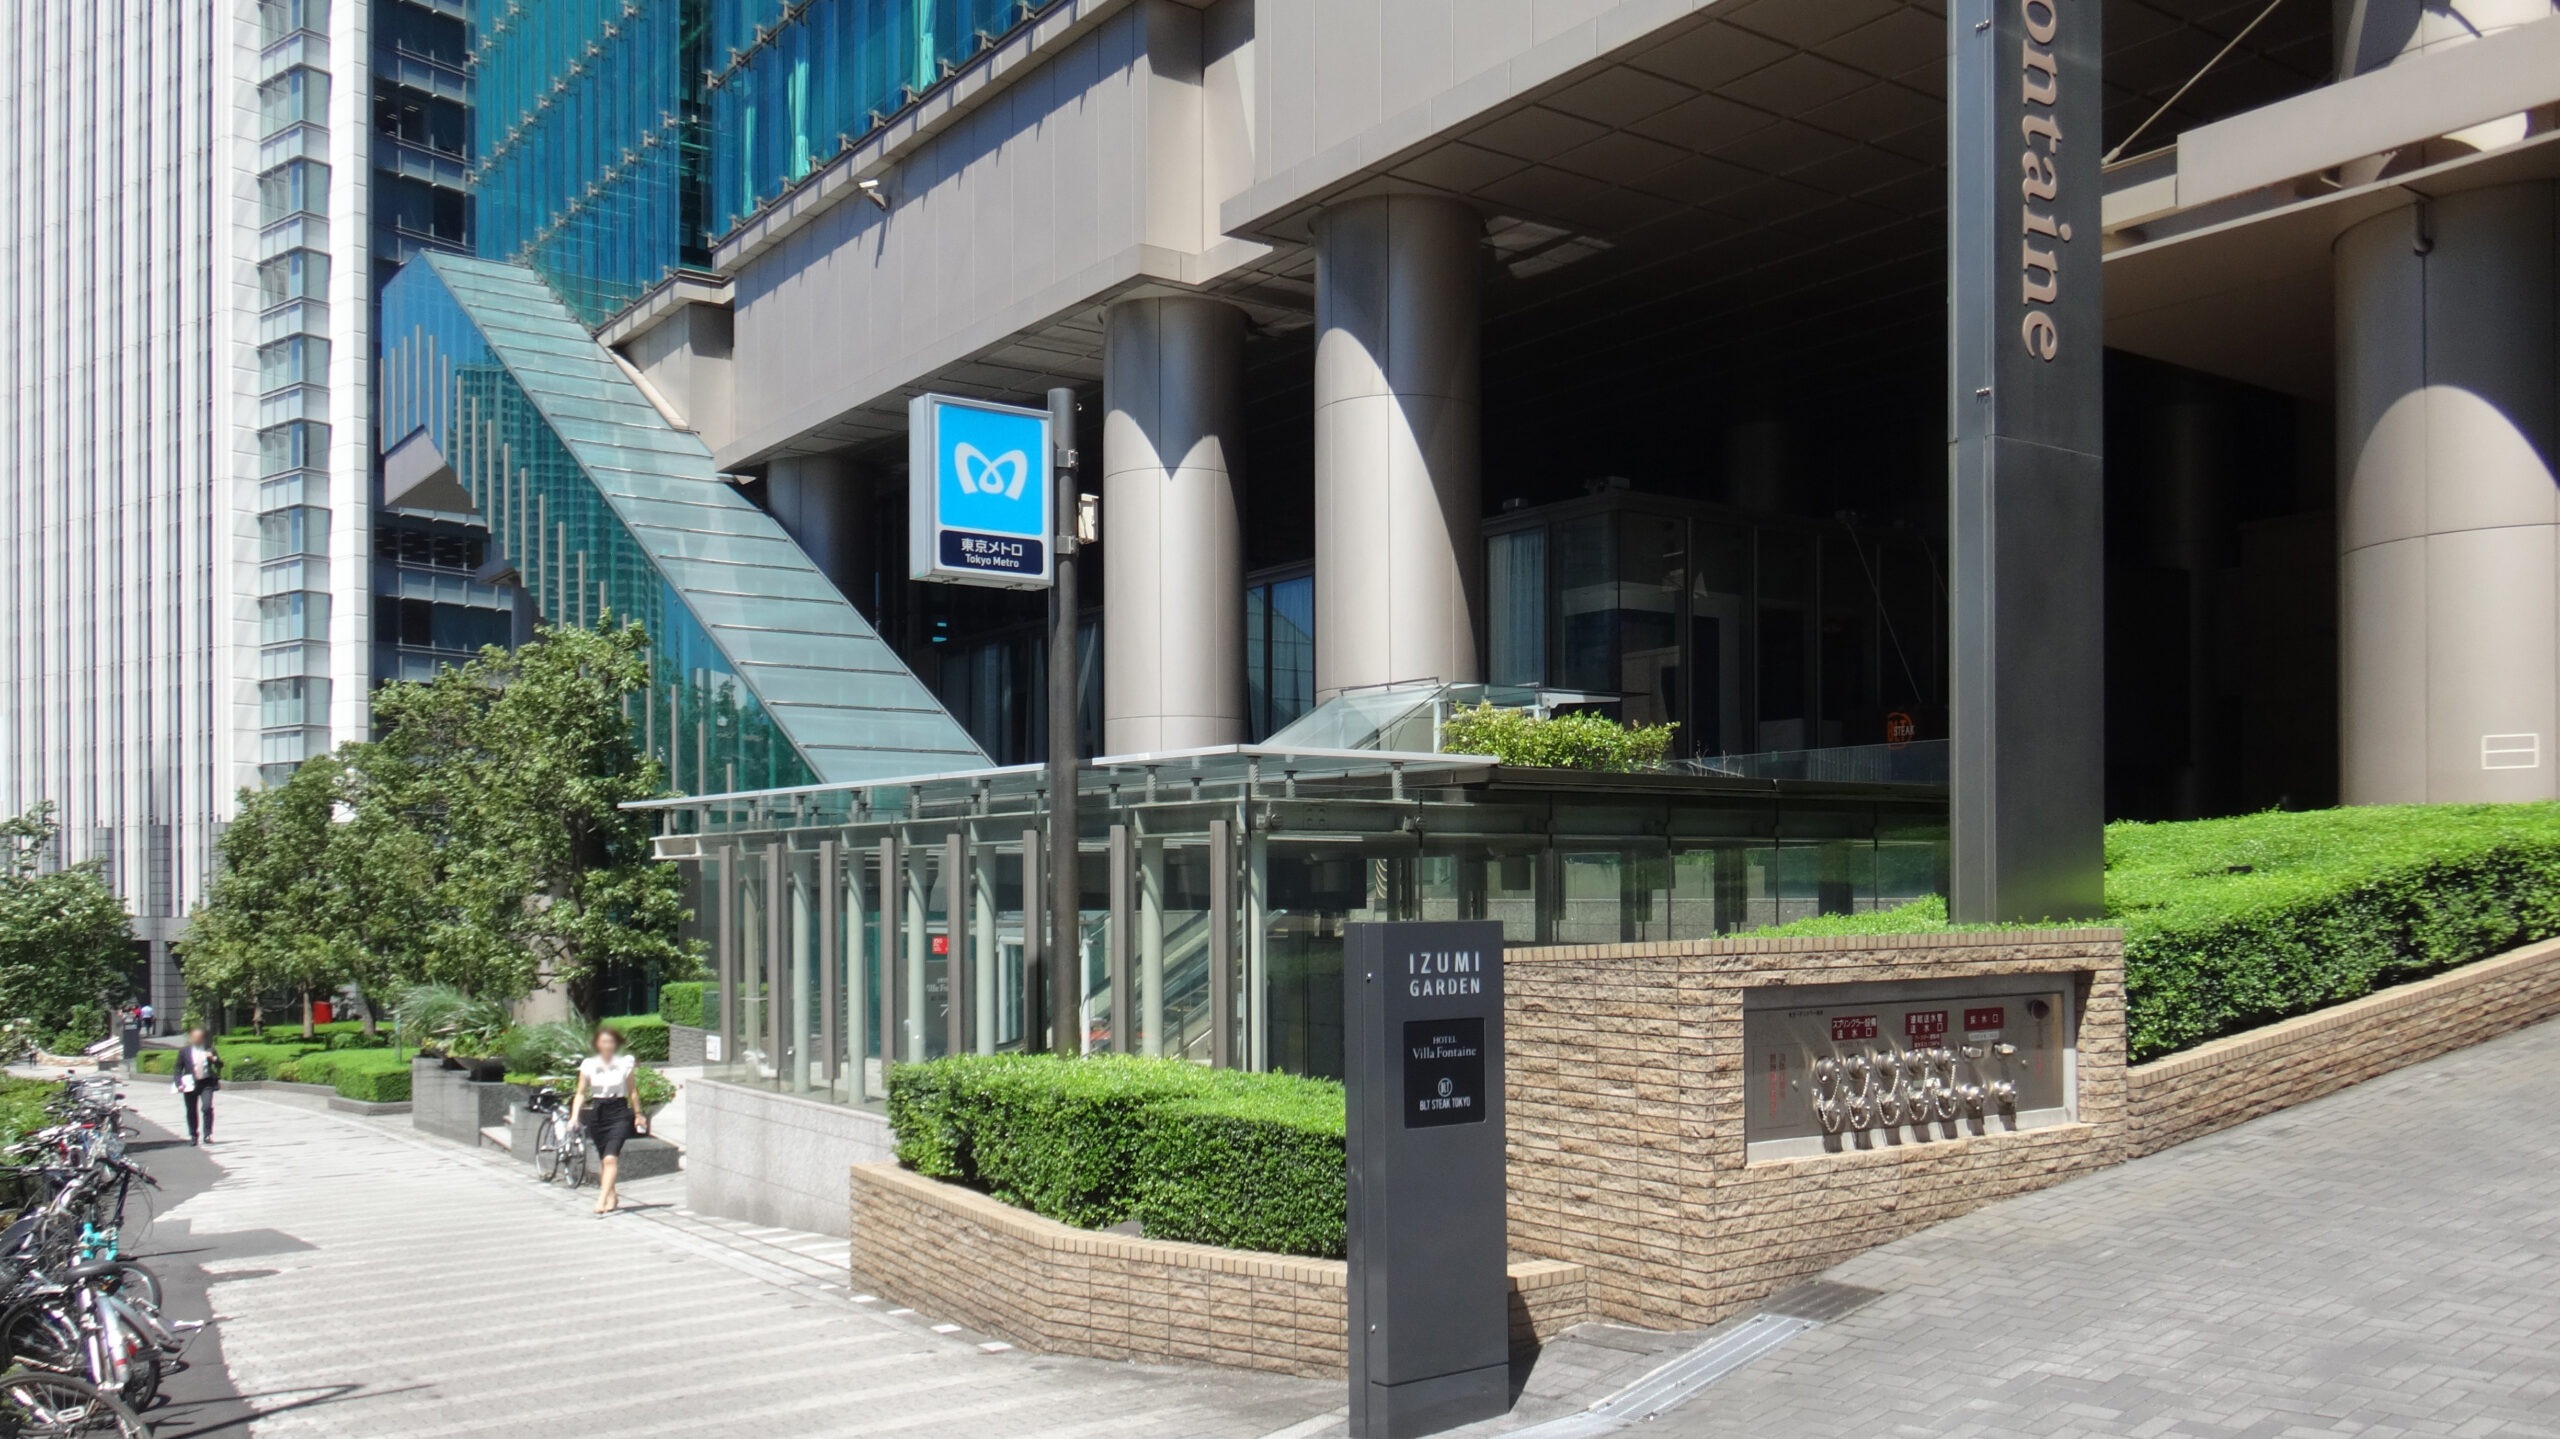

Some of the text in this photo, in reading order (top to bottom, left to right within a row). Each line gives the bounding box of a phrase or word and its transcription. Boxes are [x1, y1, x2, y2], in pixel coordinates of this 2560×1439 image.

[961, 538, 1022, 556] 東京メトロ
[965, 553, 1020, 568] Tokyo Metro
[1409, 951, 1480, 974] IZUMI
[1409, 977, 1480, 997] GARDEN
[1432, 1036, 1457, 1044] HOTEL
[1412, 1046, 1477, 1060] Villa Fontaine
[1440, 1081, 1450, 1094] BLT
[1419, 1096, 1471, 1111] BLT STEAK TOKYO
